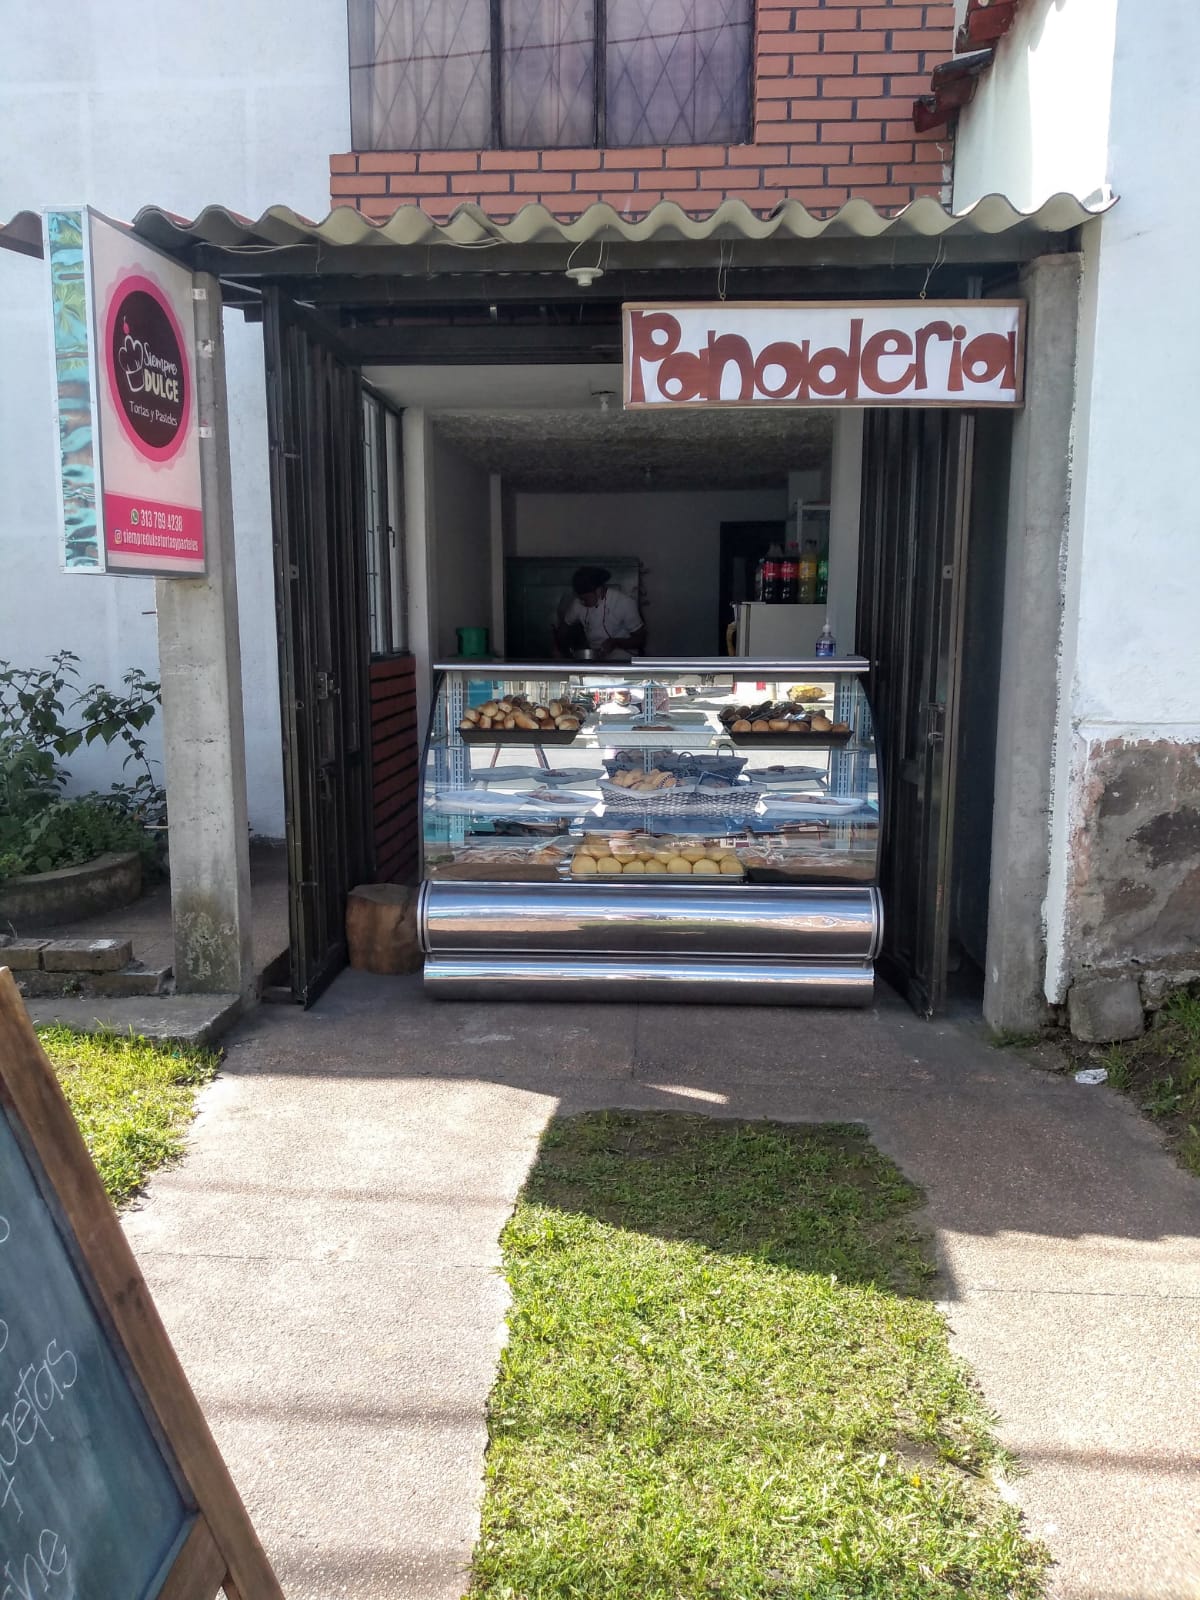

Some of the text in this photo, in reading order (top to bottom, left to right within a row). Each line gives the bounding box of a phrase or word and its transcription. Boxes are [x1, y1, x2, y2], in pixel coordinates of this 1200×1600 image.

[144, 342, 178, 377] Siempre
[631, 311, 1017, 402] Panaderia
[144, 368, 179, 403] DULCE
[129, 400, 178, 426] Tortas y Pasteles
[140, 509, 183, 532] 313 769 4238
